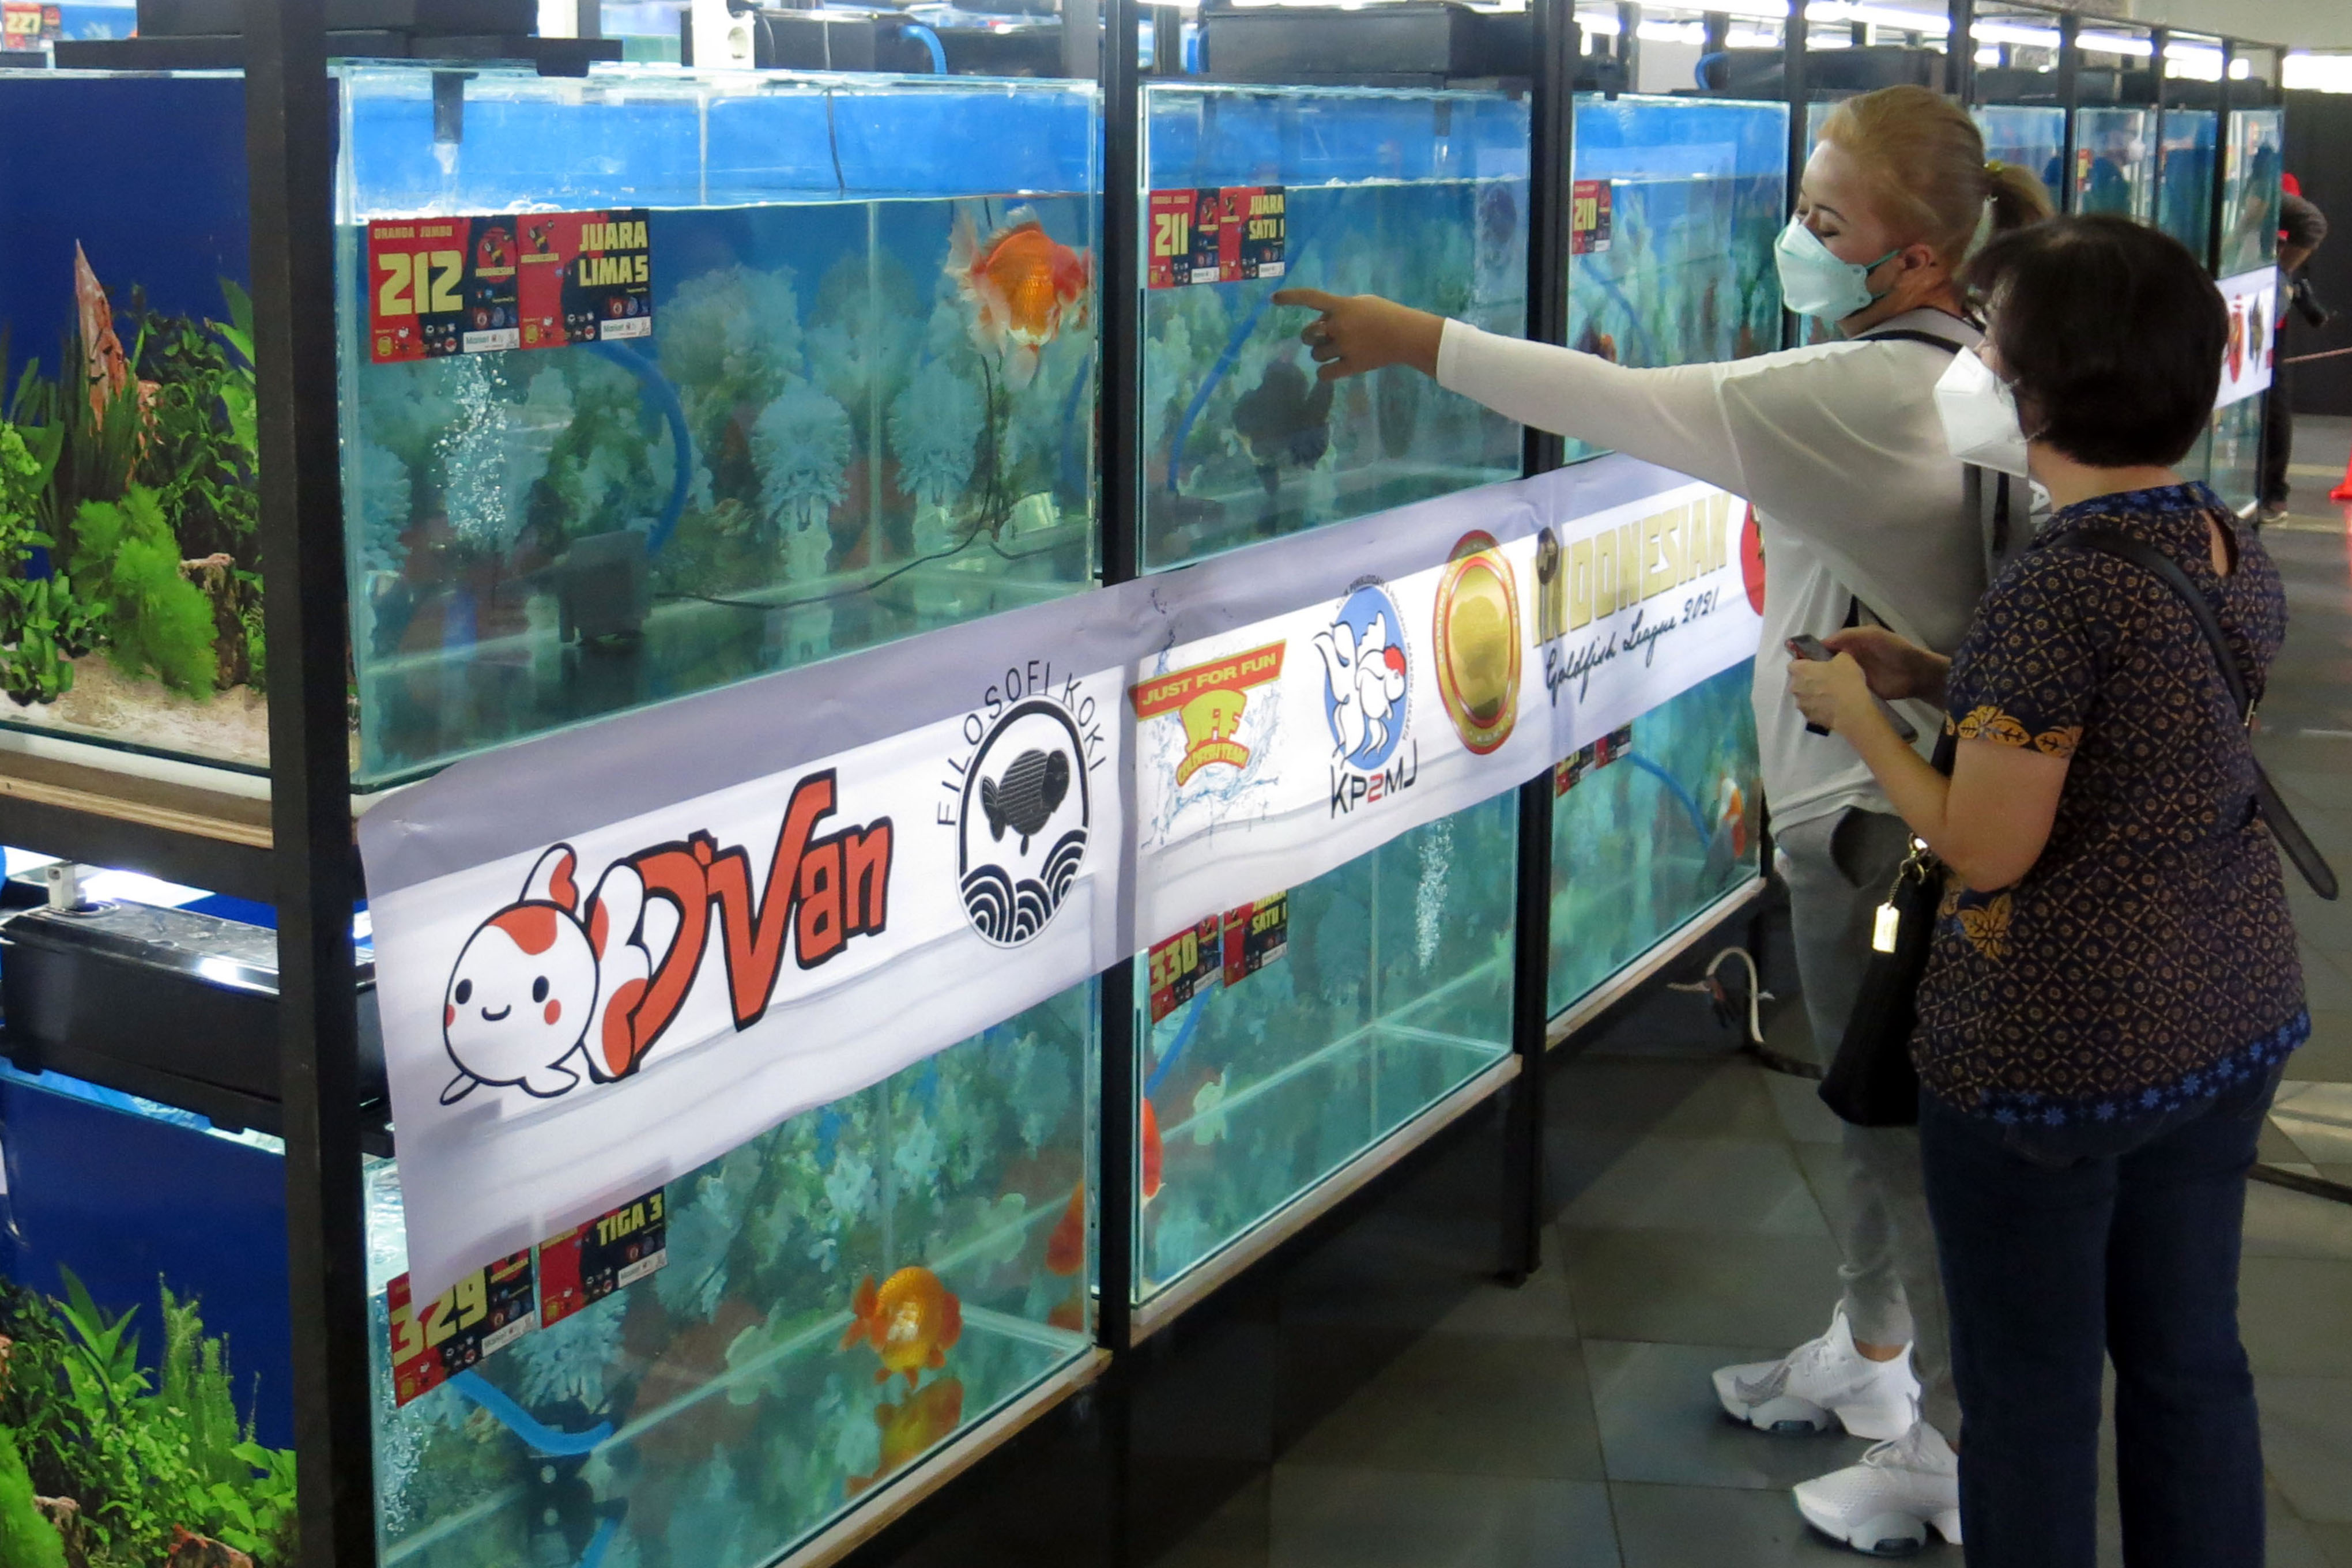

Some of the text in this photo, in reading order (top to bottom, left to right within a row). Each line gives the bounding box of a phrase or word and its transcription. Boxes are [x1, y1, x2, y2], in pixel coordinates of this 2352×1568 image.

[1249, 194, 1284, 215] JUARA
[1249, 218, 1276, 240] SATU
[579, 221, 648, 252] JUARA
[1155, 213, 1188, 256] 211
[379, 250, 463, 316] 212
[1547, 587, 1719, 708] Goldfish League 2021
[1142, 653, 1276, 706] JUST FOR FUN
[937, 659, 1106, 826] FILOSOFI KOKI
[1331, 740, 1418, 819] KP2MJ
[1252, 905, 1279, 936] SATU
[1150, 930, 1198, 996] 330
[597, 1203, 646, 1247] TIGA
[649, 1193, 664, 1221] 3
